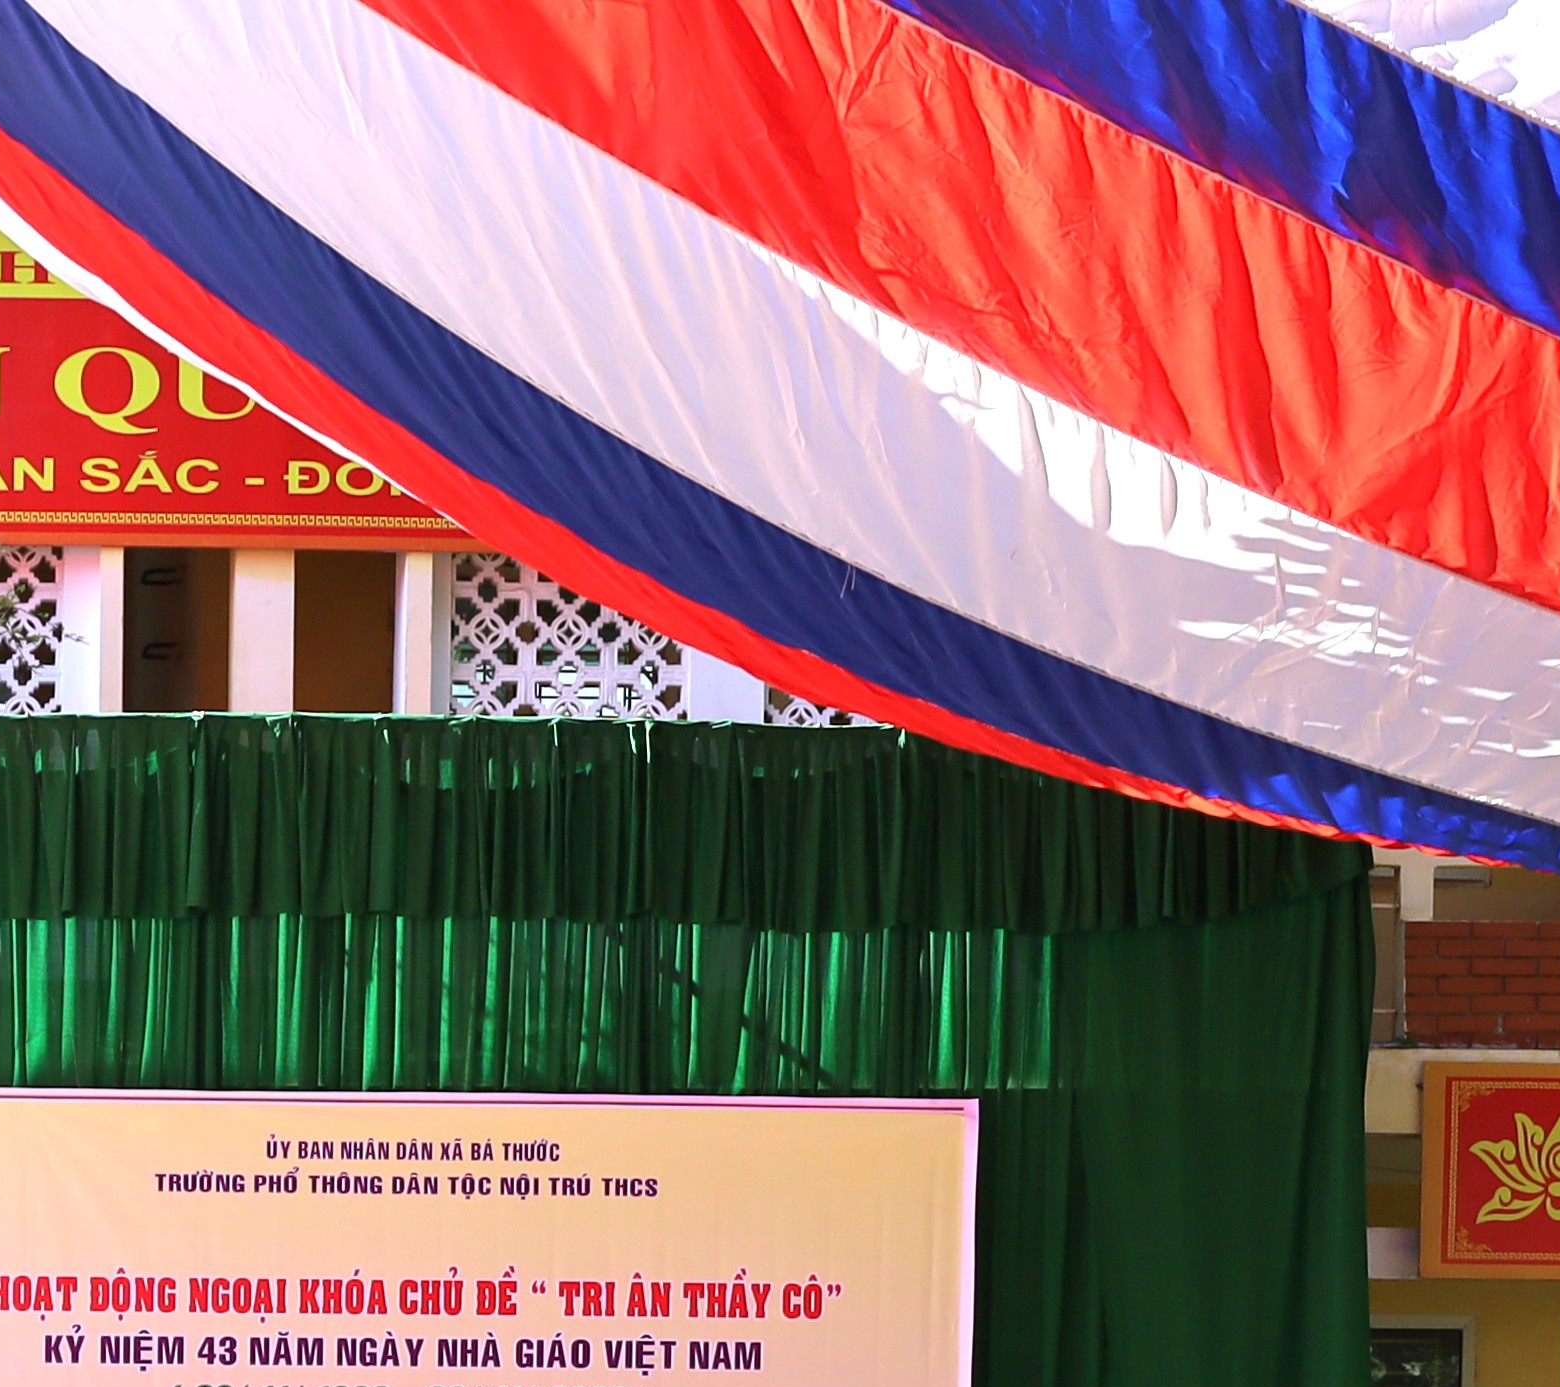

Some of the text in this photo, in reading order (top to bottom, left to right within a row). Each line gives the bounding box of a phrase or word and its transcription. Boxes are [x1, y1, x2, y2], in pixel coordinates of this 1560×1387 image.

[79, 451, 220, 494] SẮC
[266, 1134, 561, 1163] ỦY BAN NHÂN DÂN XÃ BÁ THƯỚC
[155, 1166, 659, 1200] TRƯỜNG PHỔ THÔNG DÂN TỘC NỘI TRÚ THCS
[89, 1267, 177, 1322] ĐỘNG
[188, 1277, 288, 1324] NGOẠI
[298, 1269, 388, 1315] KHÓA
[398, 1266, 464, 1316] CHỦ
[475, 1265, 518, 1316] ĐỀ
[558, 1281, 614, 1317] TRI
[626, 1272, 672, 1318] ÂN
[682, 1268, 772, 1319] THẦY
[44, 1324, 762, 1376] KỶ NIỆM 43 NĂM NGÀY NHÀ GIÁO VIỆT NAM
